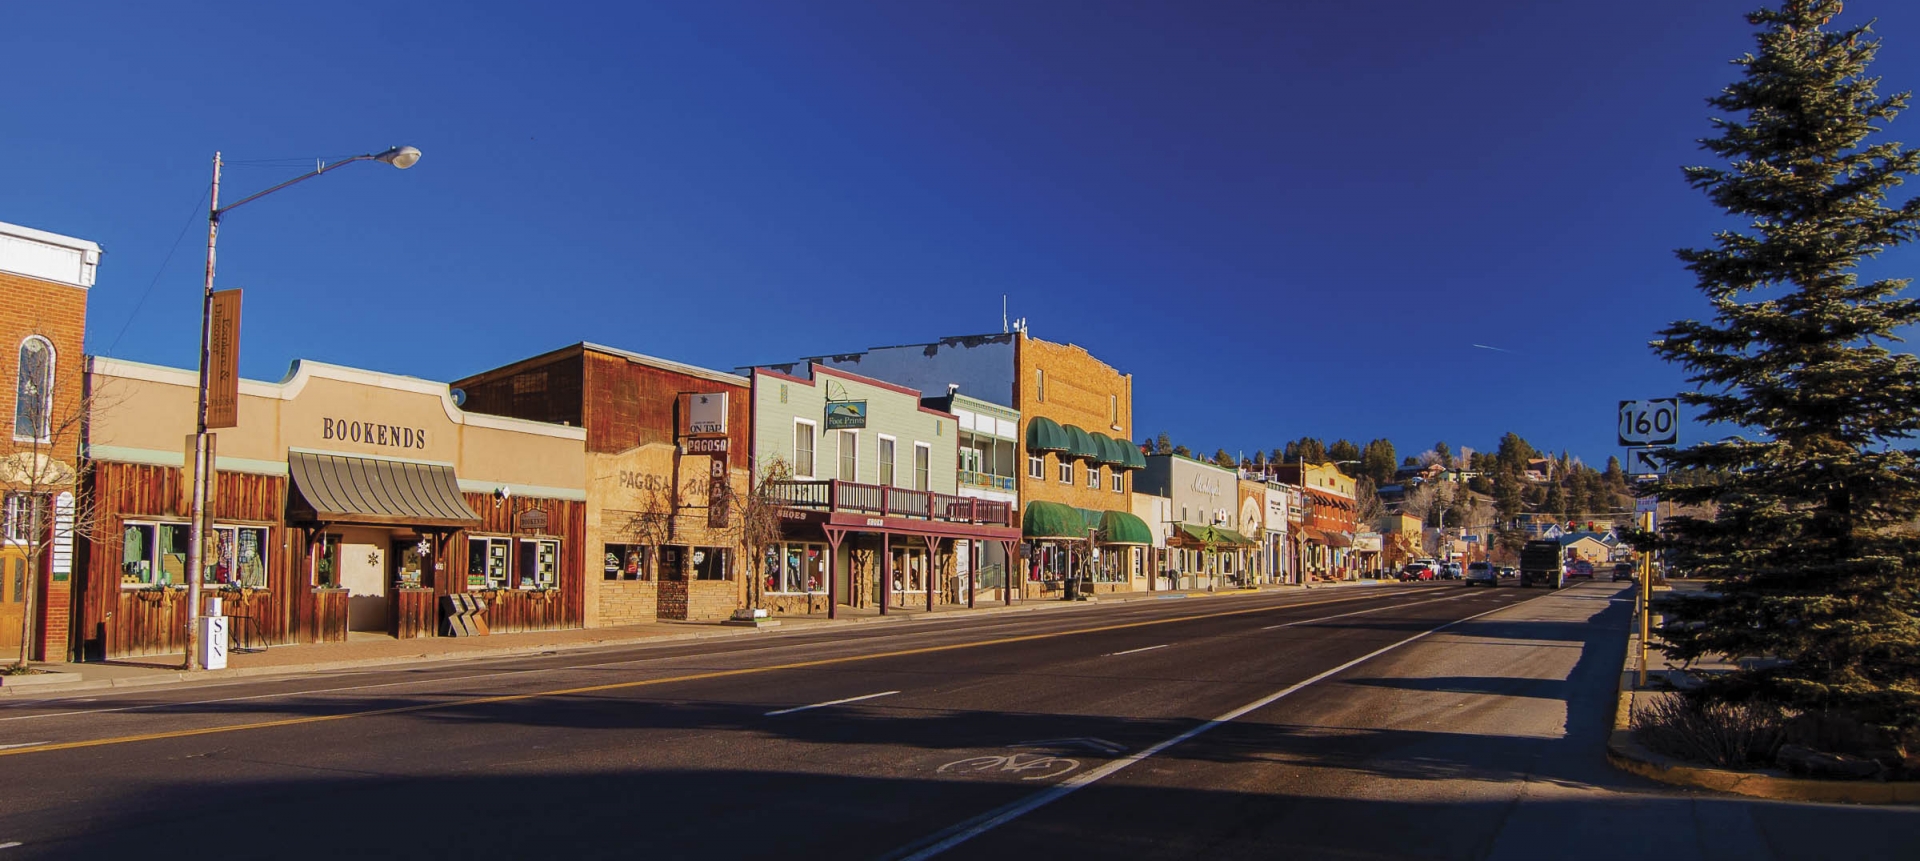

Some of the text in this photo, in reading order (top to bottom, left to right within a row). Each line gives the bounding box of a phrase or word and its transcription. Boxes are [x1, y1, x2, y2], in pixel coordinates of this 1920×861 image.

[213, 303, 223, 355] Discover
[220, 369, 231, 381] &
[690, 424, 722, 433] ON TAP
[829, 416, 864, 425] Foot Prints
[1625, 408, 1671, 434] 160
[323, 417, 425, 449] BOOKENDS
[688, 439, 727, 451] PAGOSA
[620, 470, 671, 493] PAGOSA
[777, 509, 807, 520] SHOES
[214, 618, 222, 658] SUN
